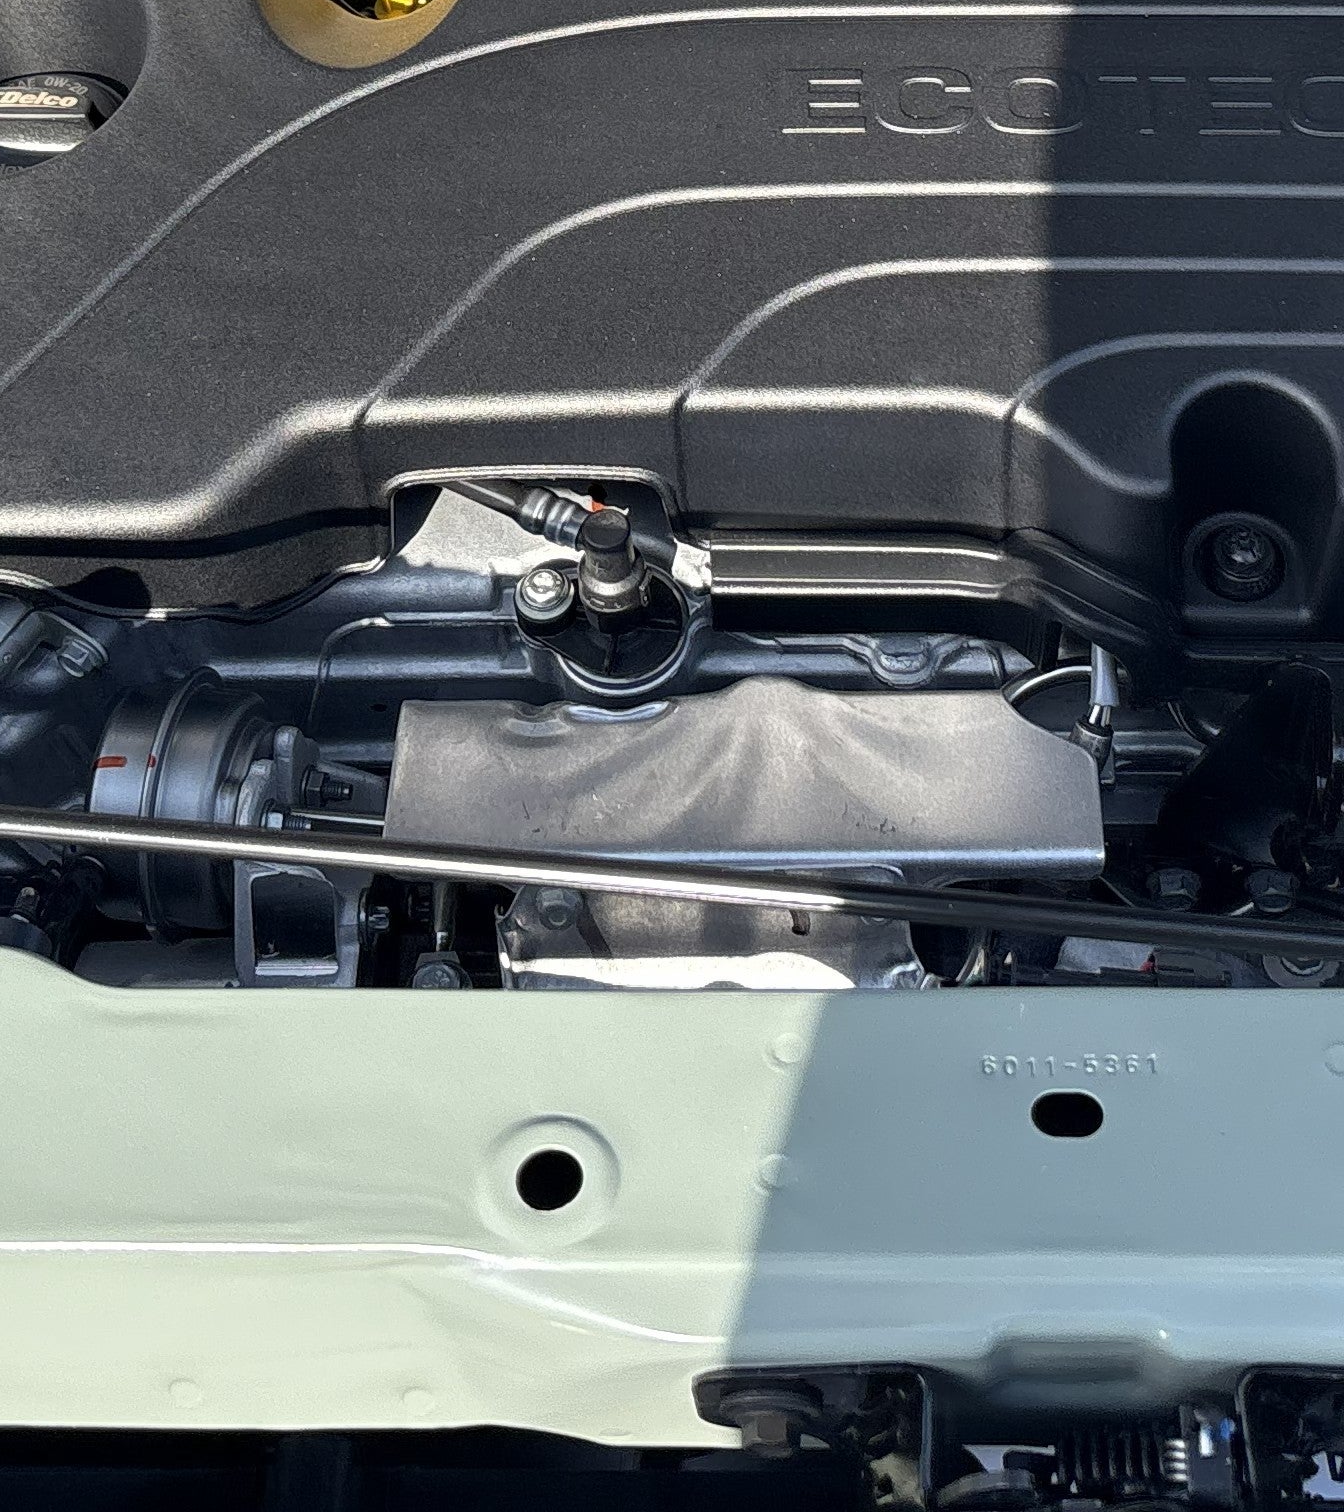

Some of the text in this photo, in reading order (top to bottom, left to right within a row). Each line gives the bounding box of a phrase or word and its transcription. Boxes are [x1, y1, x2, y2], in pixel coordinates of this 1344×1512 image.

[8, 75, 89, 97] AE 0W-20
[981, 1052, 1158, 1078] 6011-5361
